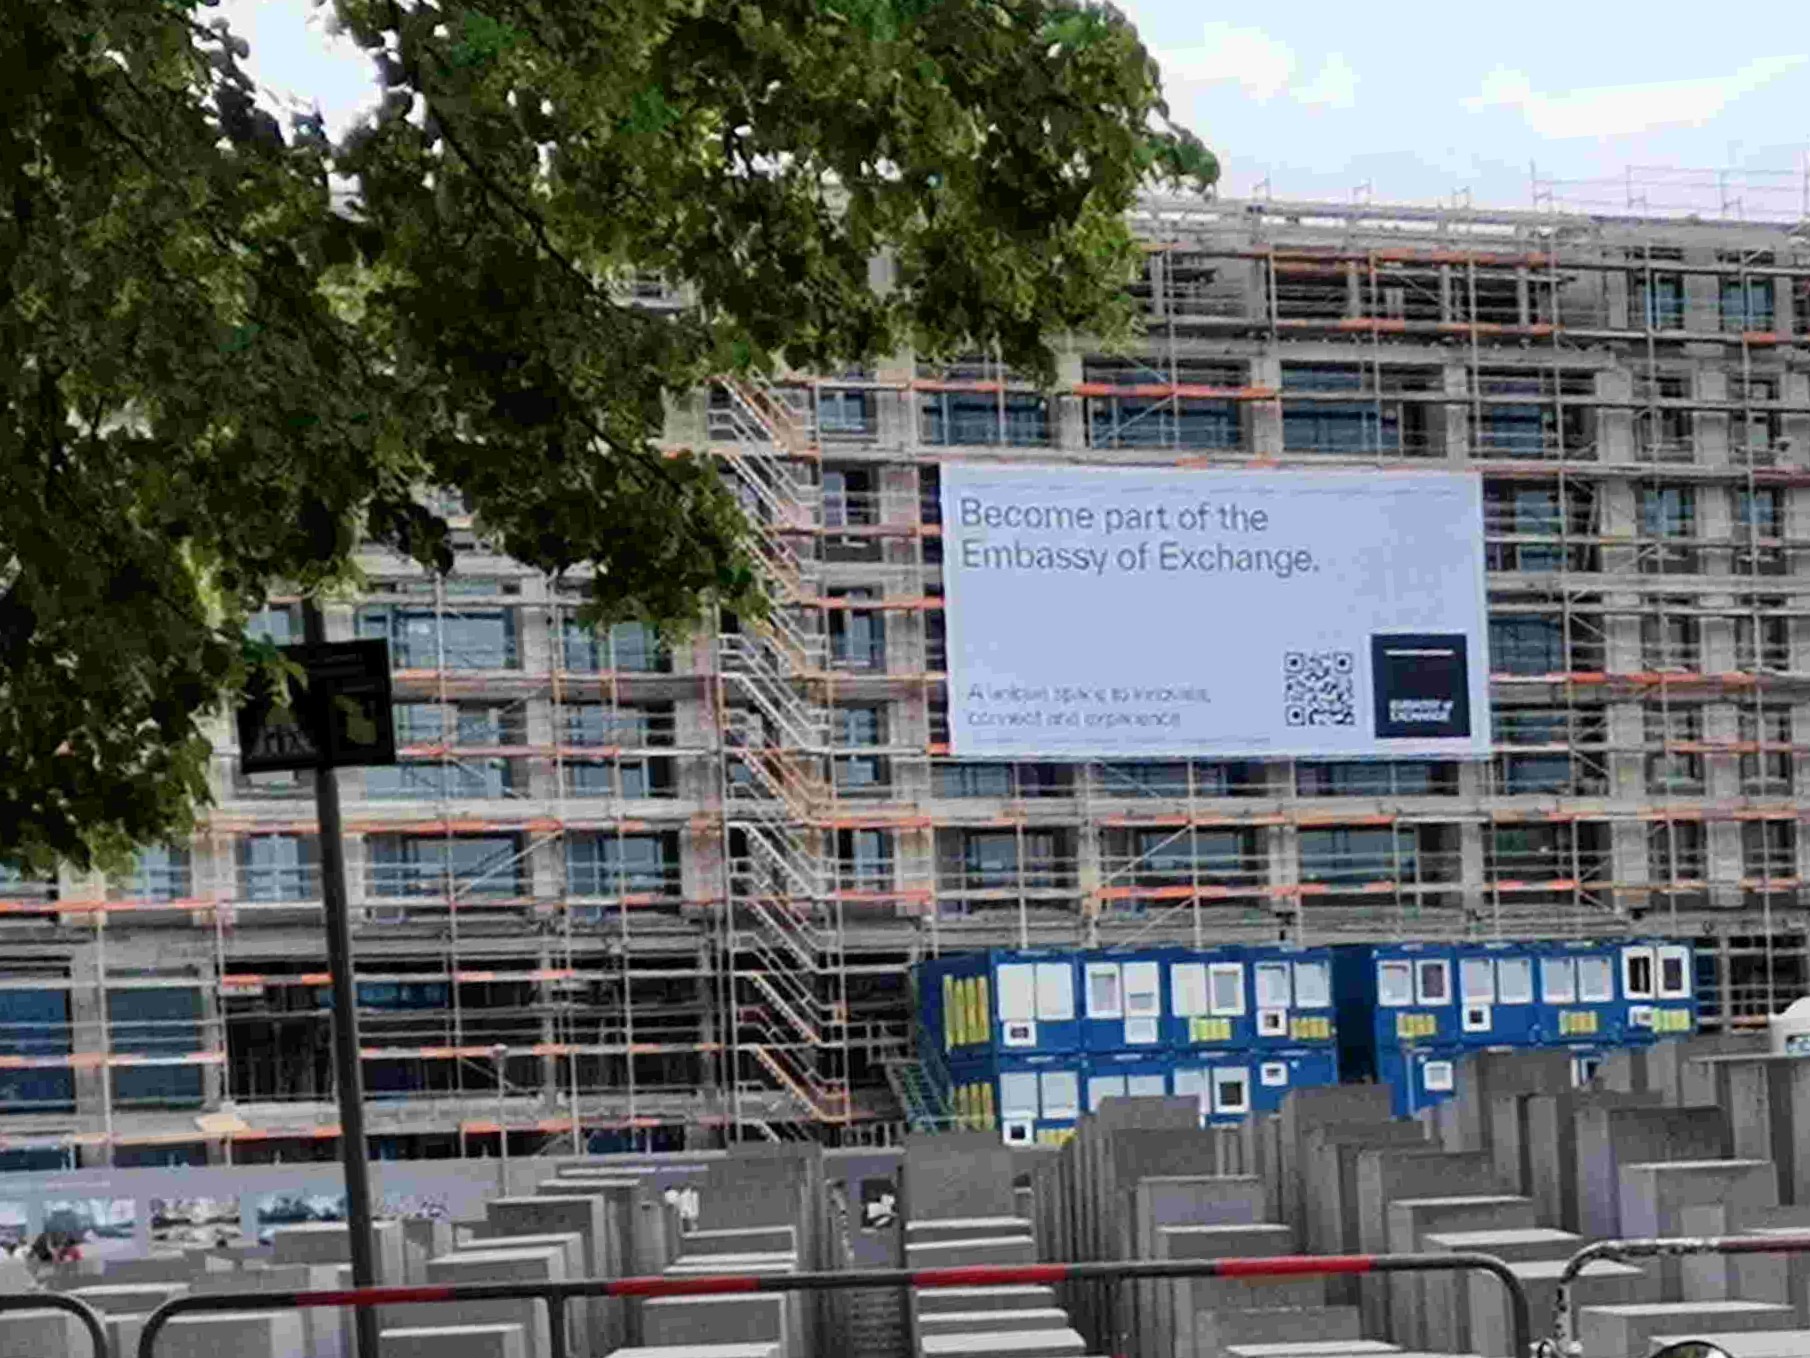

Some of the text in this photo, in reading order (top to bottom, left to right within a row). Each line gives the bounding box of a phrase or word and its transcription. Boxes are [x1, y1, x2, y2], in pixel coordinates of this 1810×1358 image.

[961, 498, 1269, 534] Become part of the
[962, 538, 1320, 578] Embassy of Exchange.
